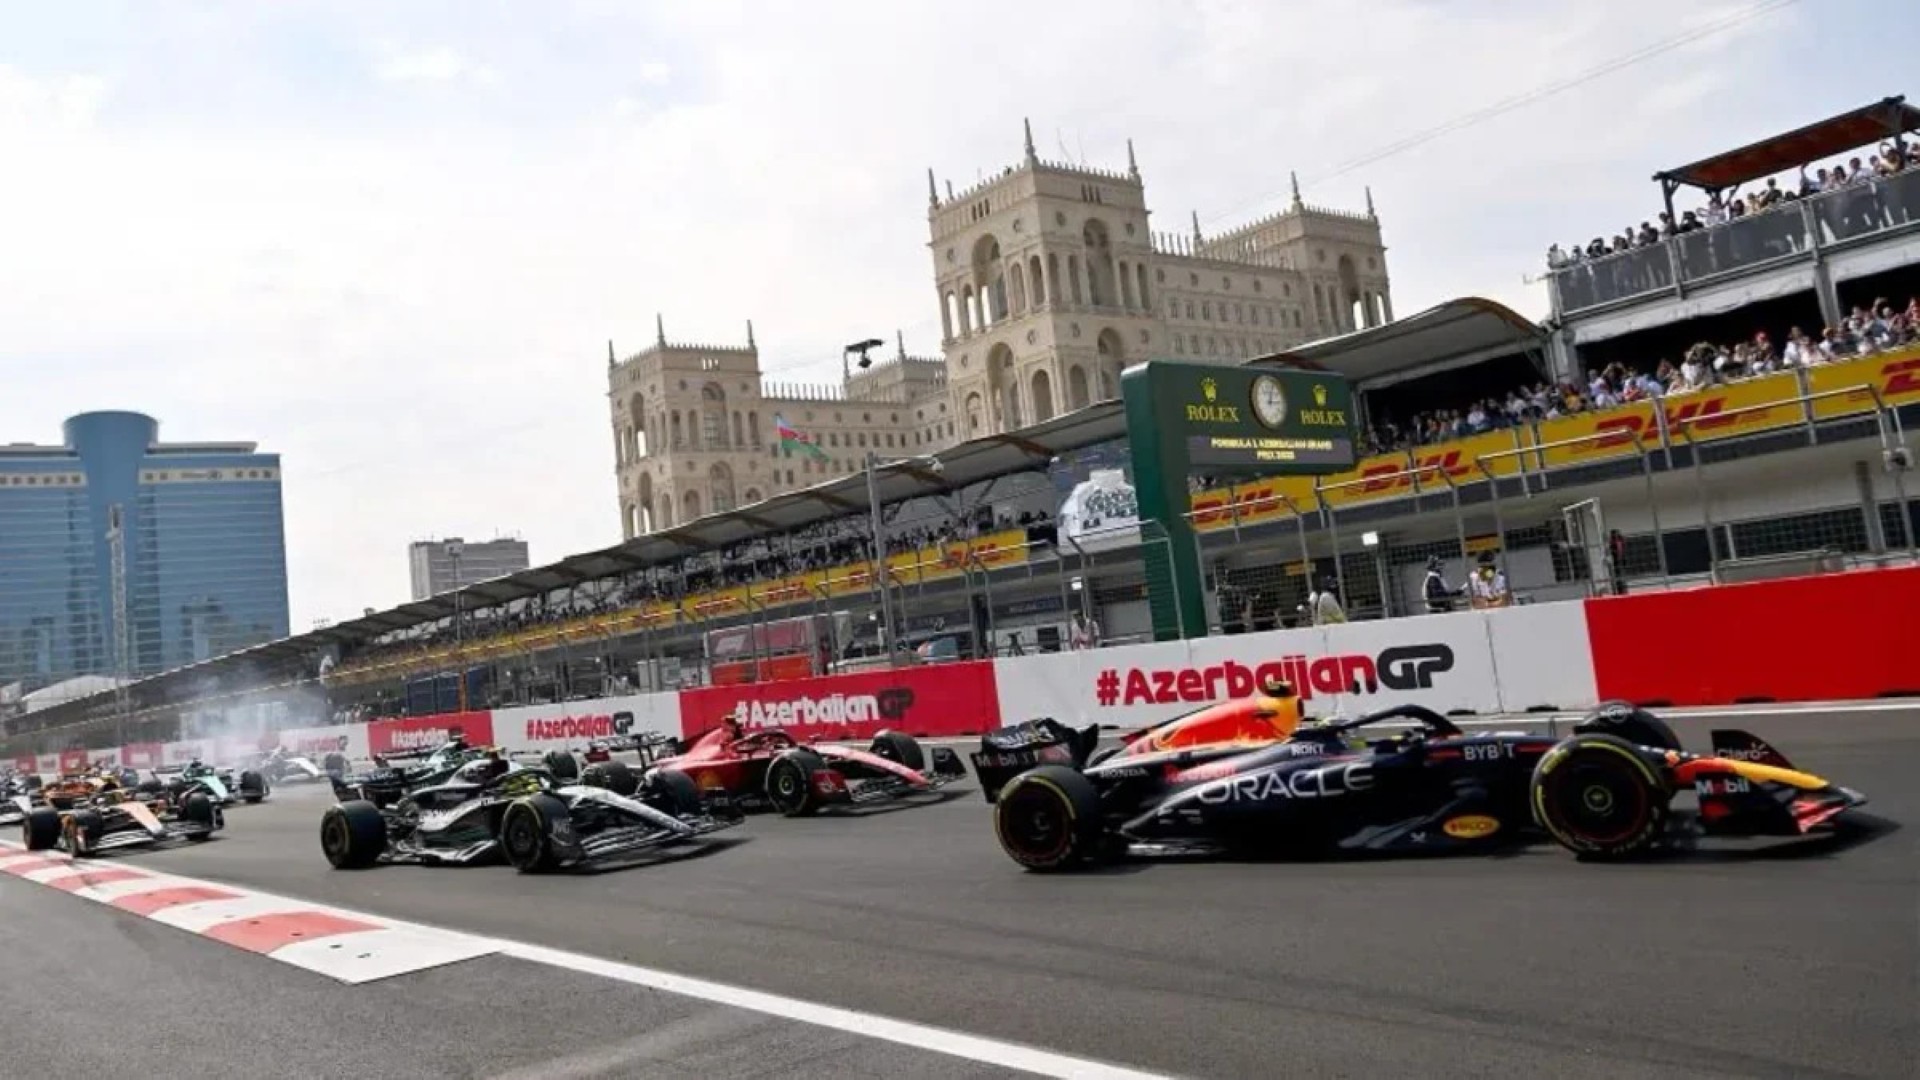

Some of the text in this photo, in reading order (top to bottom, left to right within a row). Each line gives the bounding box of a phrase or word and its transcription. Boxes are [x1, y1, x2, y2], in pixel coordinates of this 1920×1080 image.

[1186, 405, 1239, 423] ROLEX
[1301, 410, 1346, 426] ROLEX
[1596, 398, 1736, 447] DHL
[1363, 451, 1468, 492] DHL
[1193, 489, 1279, 523] DHL
[1096, 643, 1455, 706] #AzerbaijanGP
[735, 686, 915, 729] #AzerbaijanGP
[526, 710, 634, 741] #AzerbaijanGP
[975, 751, 1017, 768] Mobil
[1100, 767, 1148, 779] HONDA
[1198, 762, 1375, 804] ORACLE
[1695, 777, 1750, 794] Mobil
